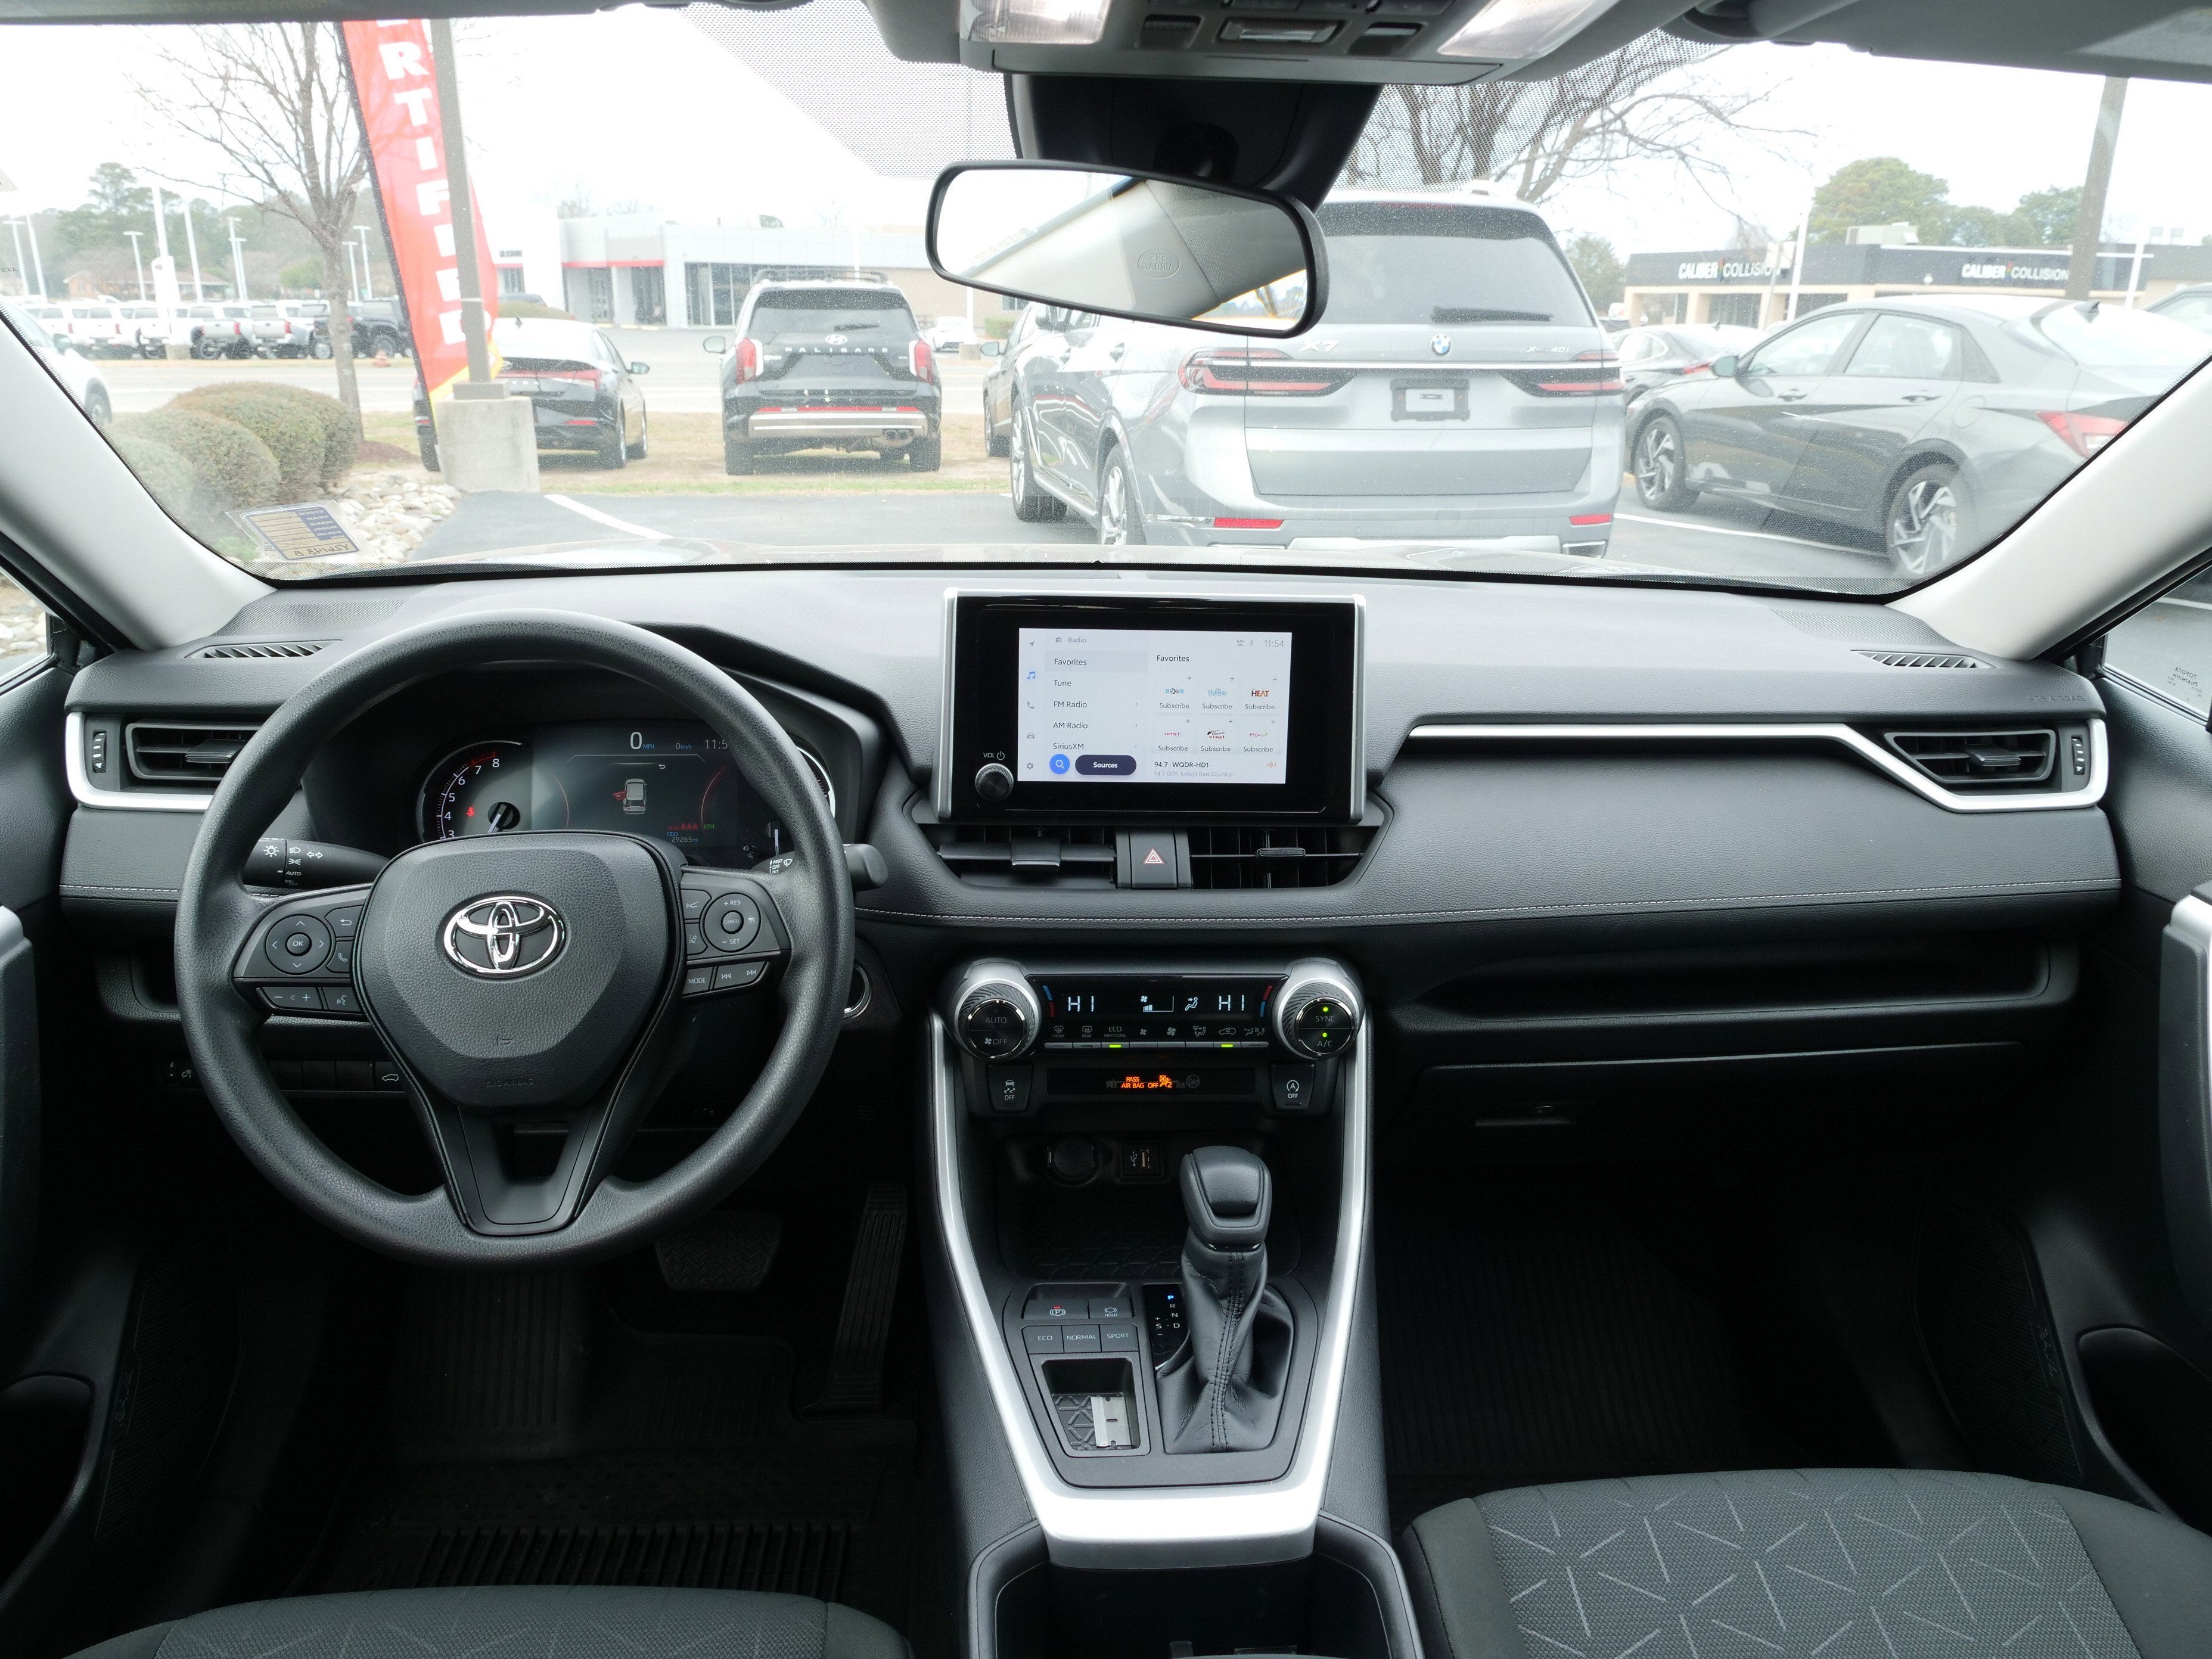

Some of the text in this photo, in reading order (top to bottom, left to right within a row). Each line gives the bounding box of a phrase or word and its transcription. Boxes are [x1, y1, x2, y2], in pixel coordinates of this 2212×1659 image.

[376, 20, 491, 344] RTIFIED
[1678, 262, 1718, 279] CALIBER
[1299, 338, 1339, 353] X7
[630, 731, 643, 750] 0
[704, 740, 728, 750] 11:5
[492, 758, 500, 768] 8
[474, 765, 482, 775] 7
[458, 776, 465, 785] 6
[449, 793, 455, 802] 5
[444, 812, 452, 821] 4
[1068, 995, 1094, 1012] HI
[1218, 994, 1244, 1012] HI
